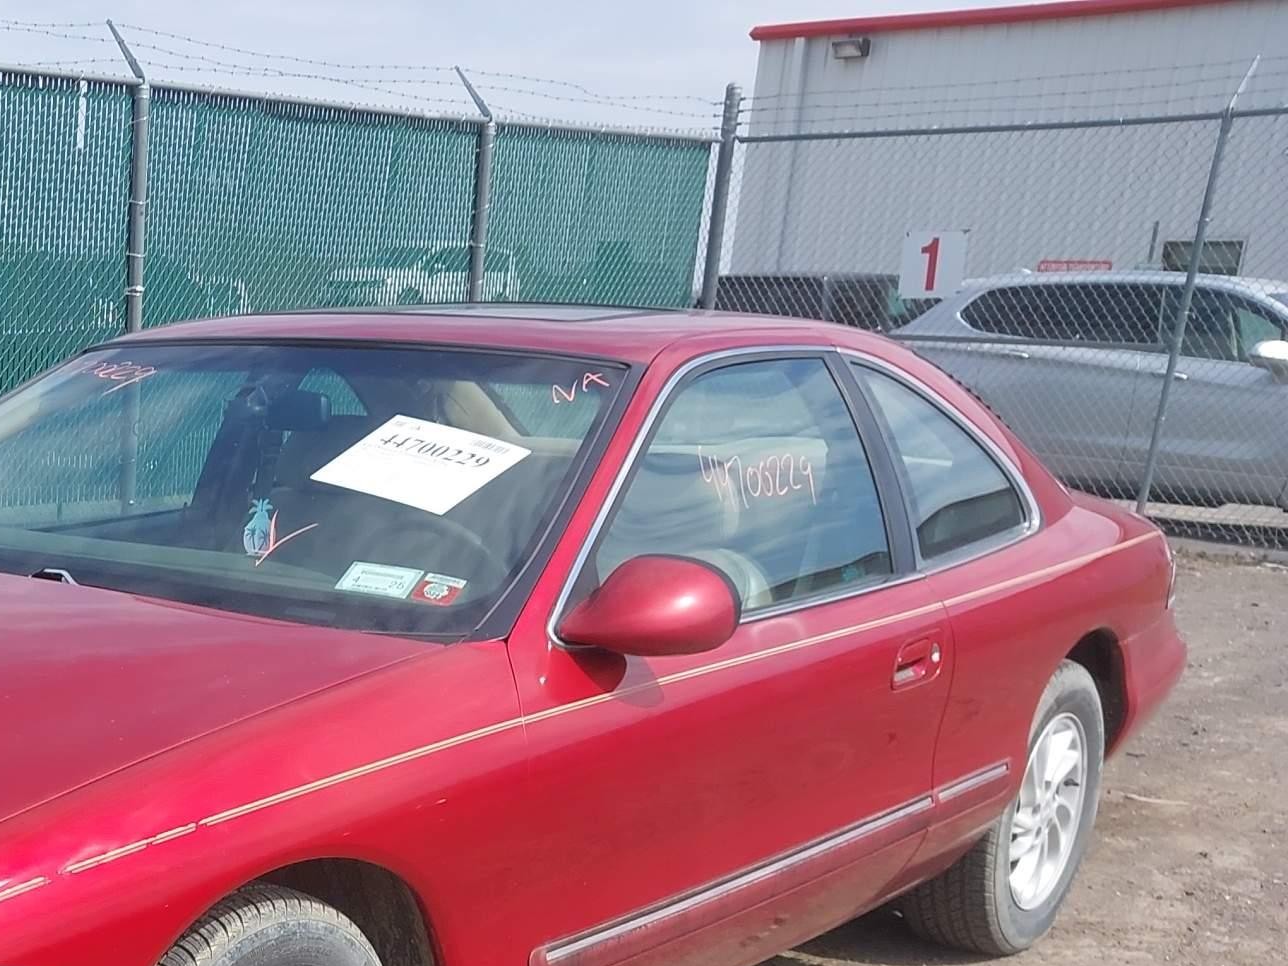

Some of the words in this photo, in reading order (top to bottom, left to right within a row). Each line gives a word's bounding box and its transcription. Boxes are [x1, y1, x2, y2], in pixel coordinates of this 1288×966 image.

[920, 237, 940, 291] 1
[380, 433, 490, 468] 44700229
[697, 446, 817, 511] 44700229
